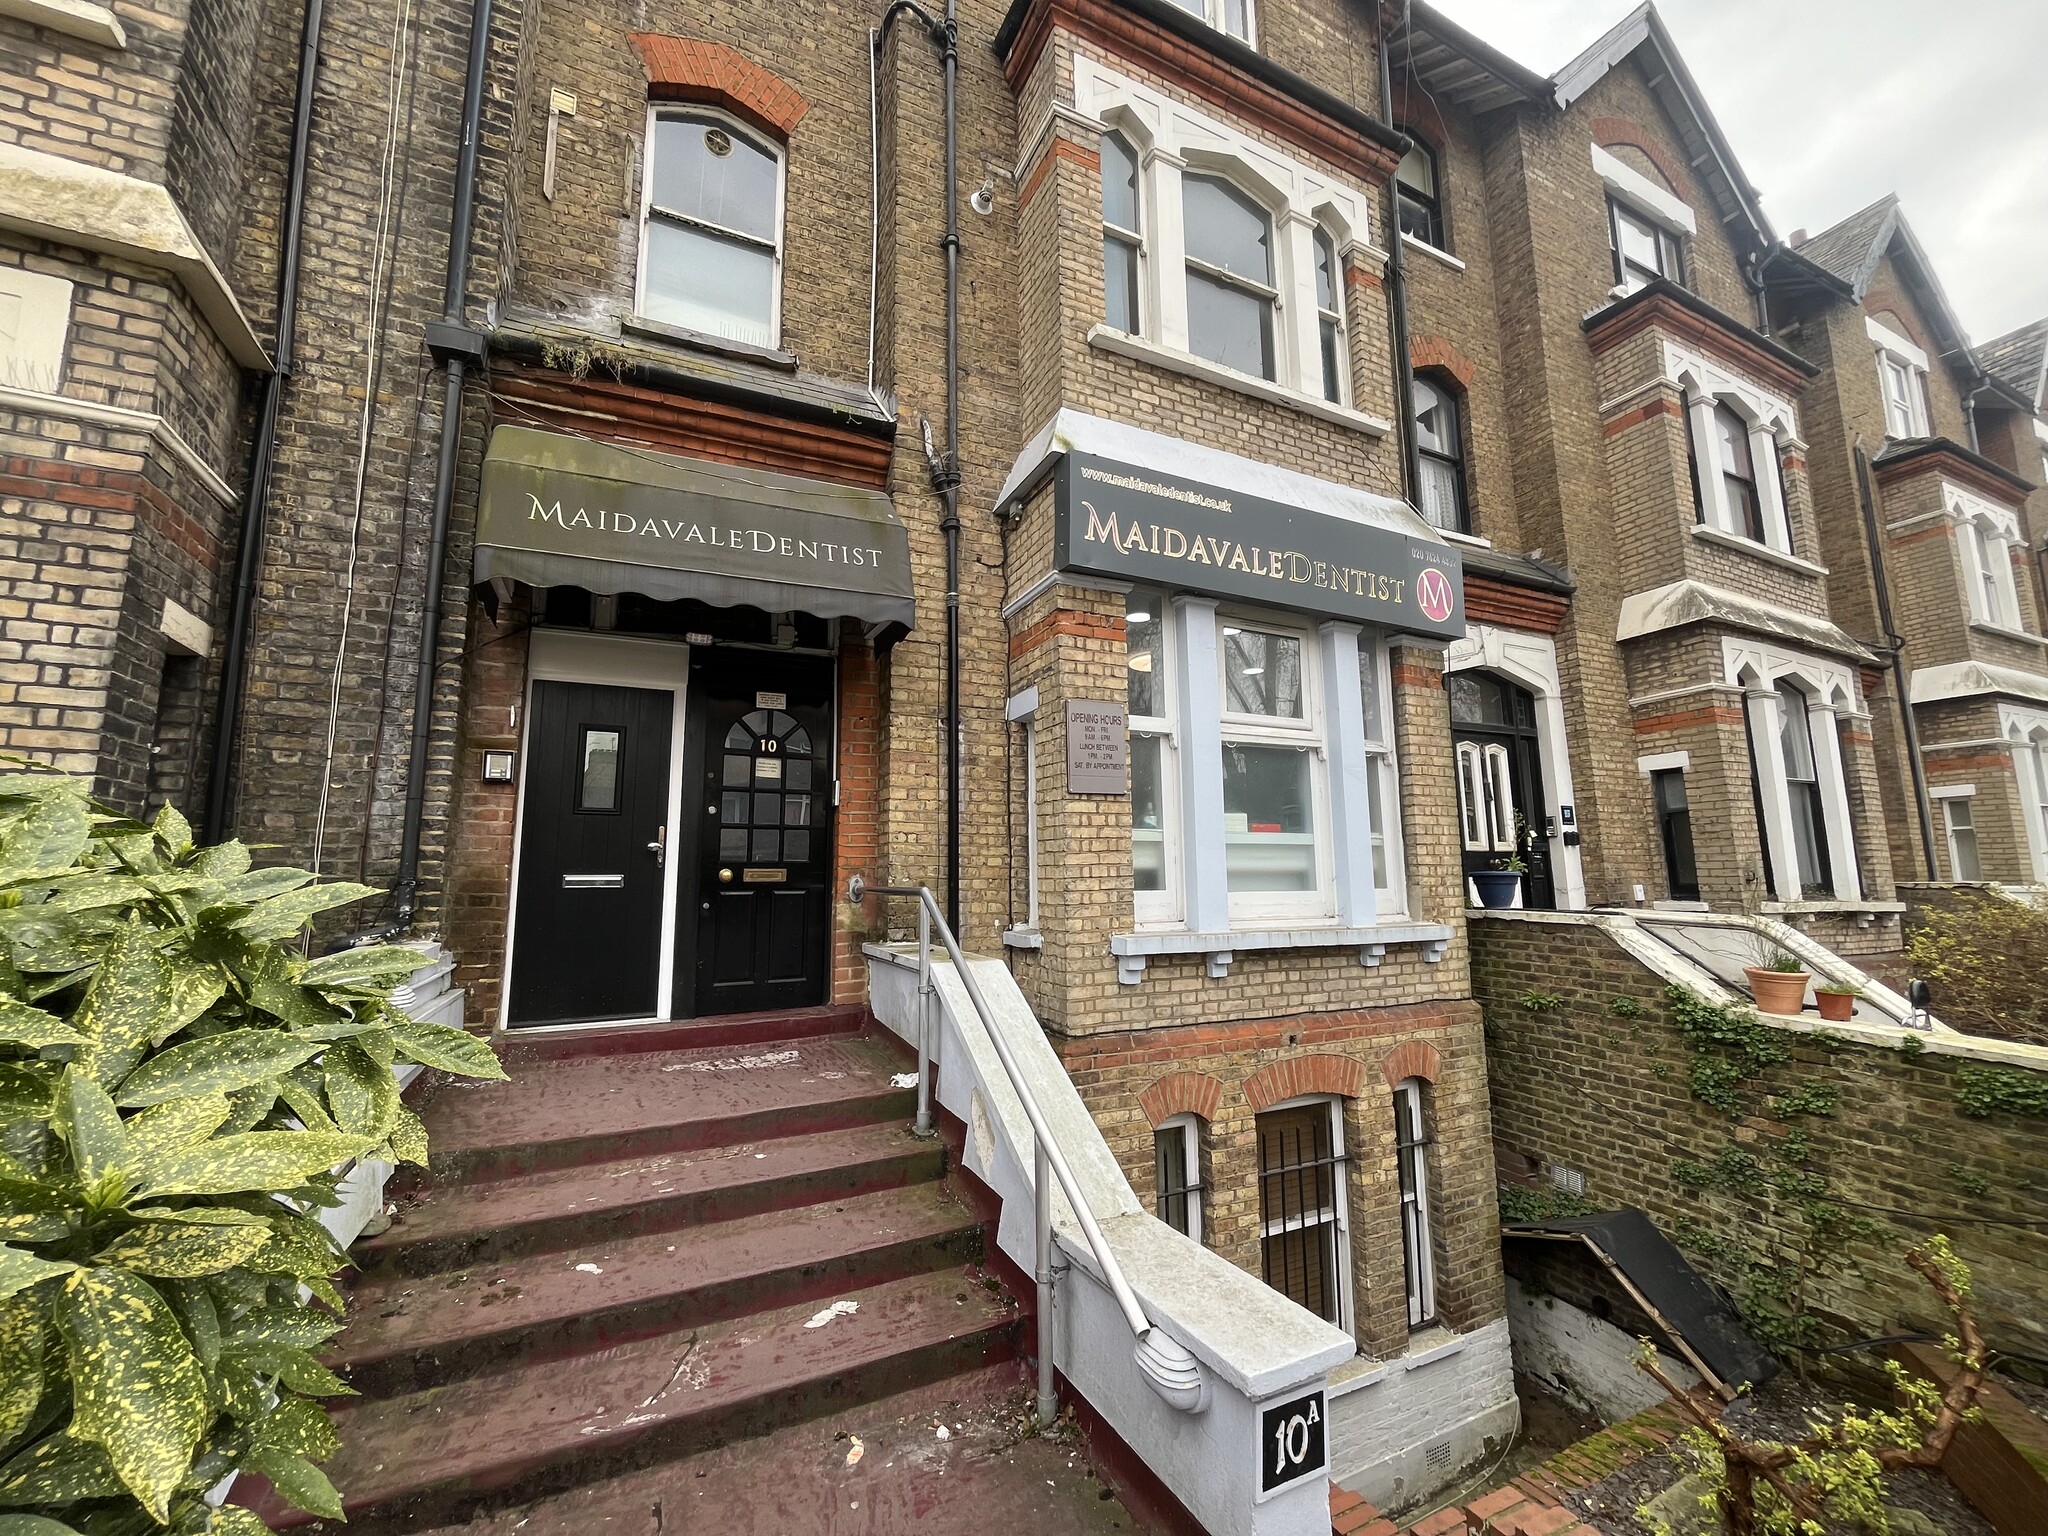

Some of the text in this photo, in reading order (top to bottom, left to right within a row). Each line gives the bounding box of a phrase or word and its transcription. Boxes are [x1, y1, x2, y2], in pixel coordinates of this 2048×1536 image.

[1080, 467, 1232, 513] www.maidavaledentist.co.uk
[1412, 547, 1424, 560] 020
[1422, 572, 1450, 616] M
[1070, 712, 1122, 725] OPENING HOURS
[760, 739, 777, 753] 10
